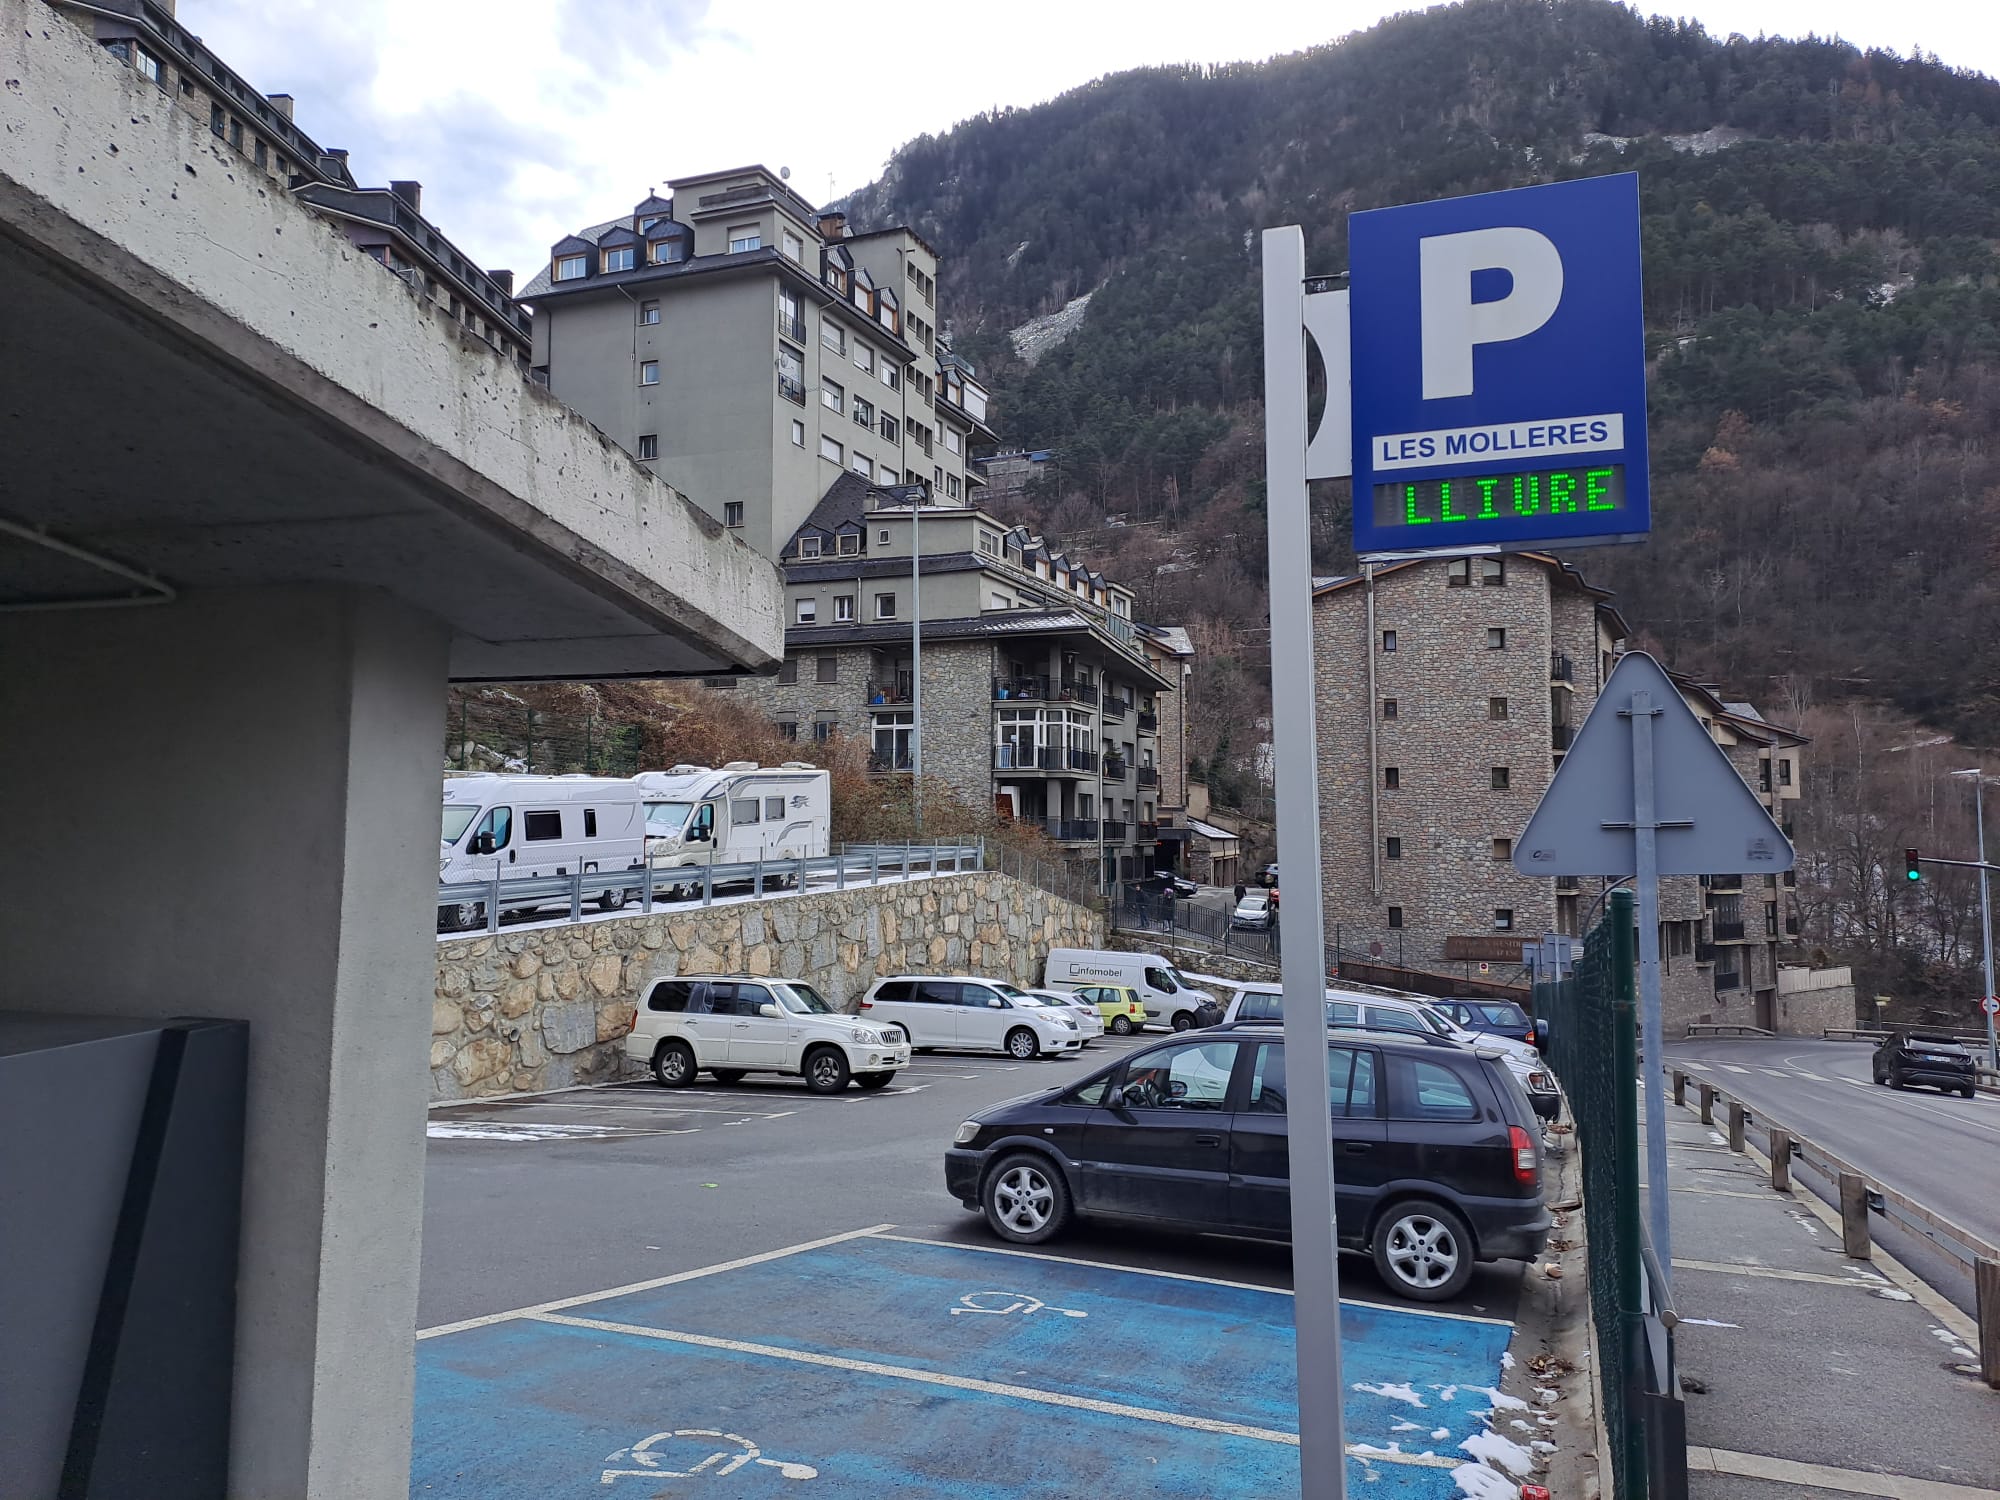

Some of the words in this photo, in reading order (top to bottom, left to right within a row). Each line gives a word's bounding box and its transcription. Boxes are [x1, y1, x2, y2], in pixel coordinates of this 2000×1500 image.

[1420, 227, 1564, 400] P
[1382, 436, 1436, 461] LES
[1445, 421, 1609, 455] MOLLERES
[1405, 469, 1616, 525] LLIURE
